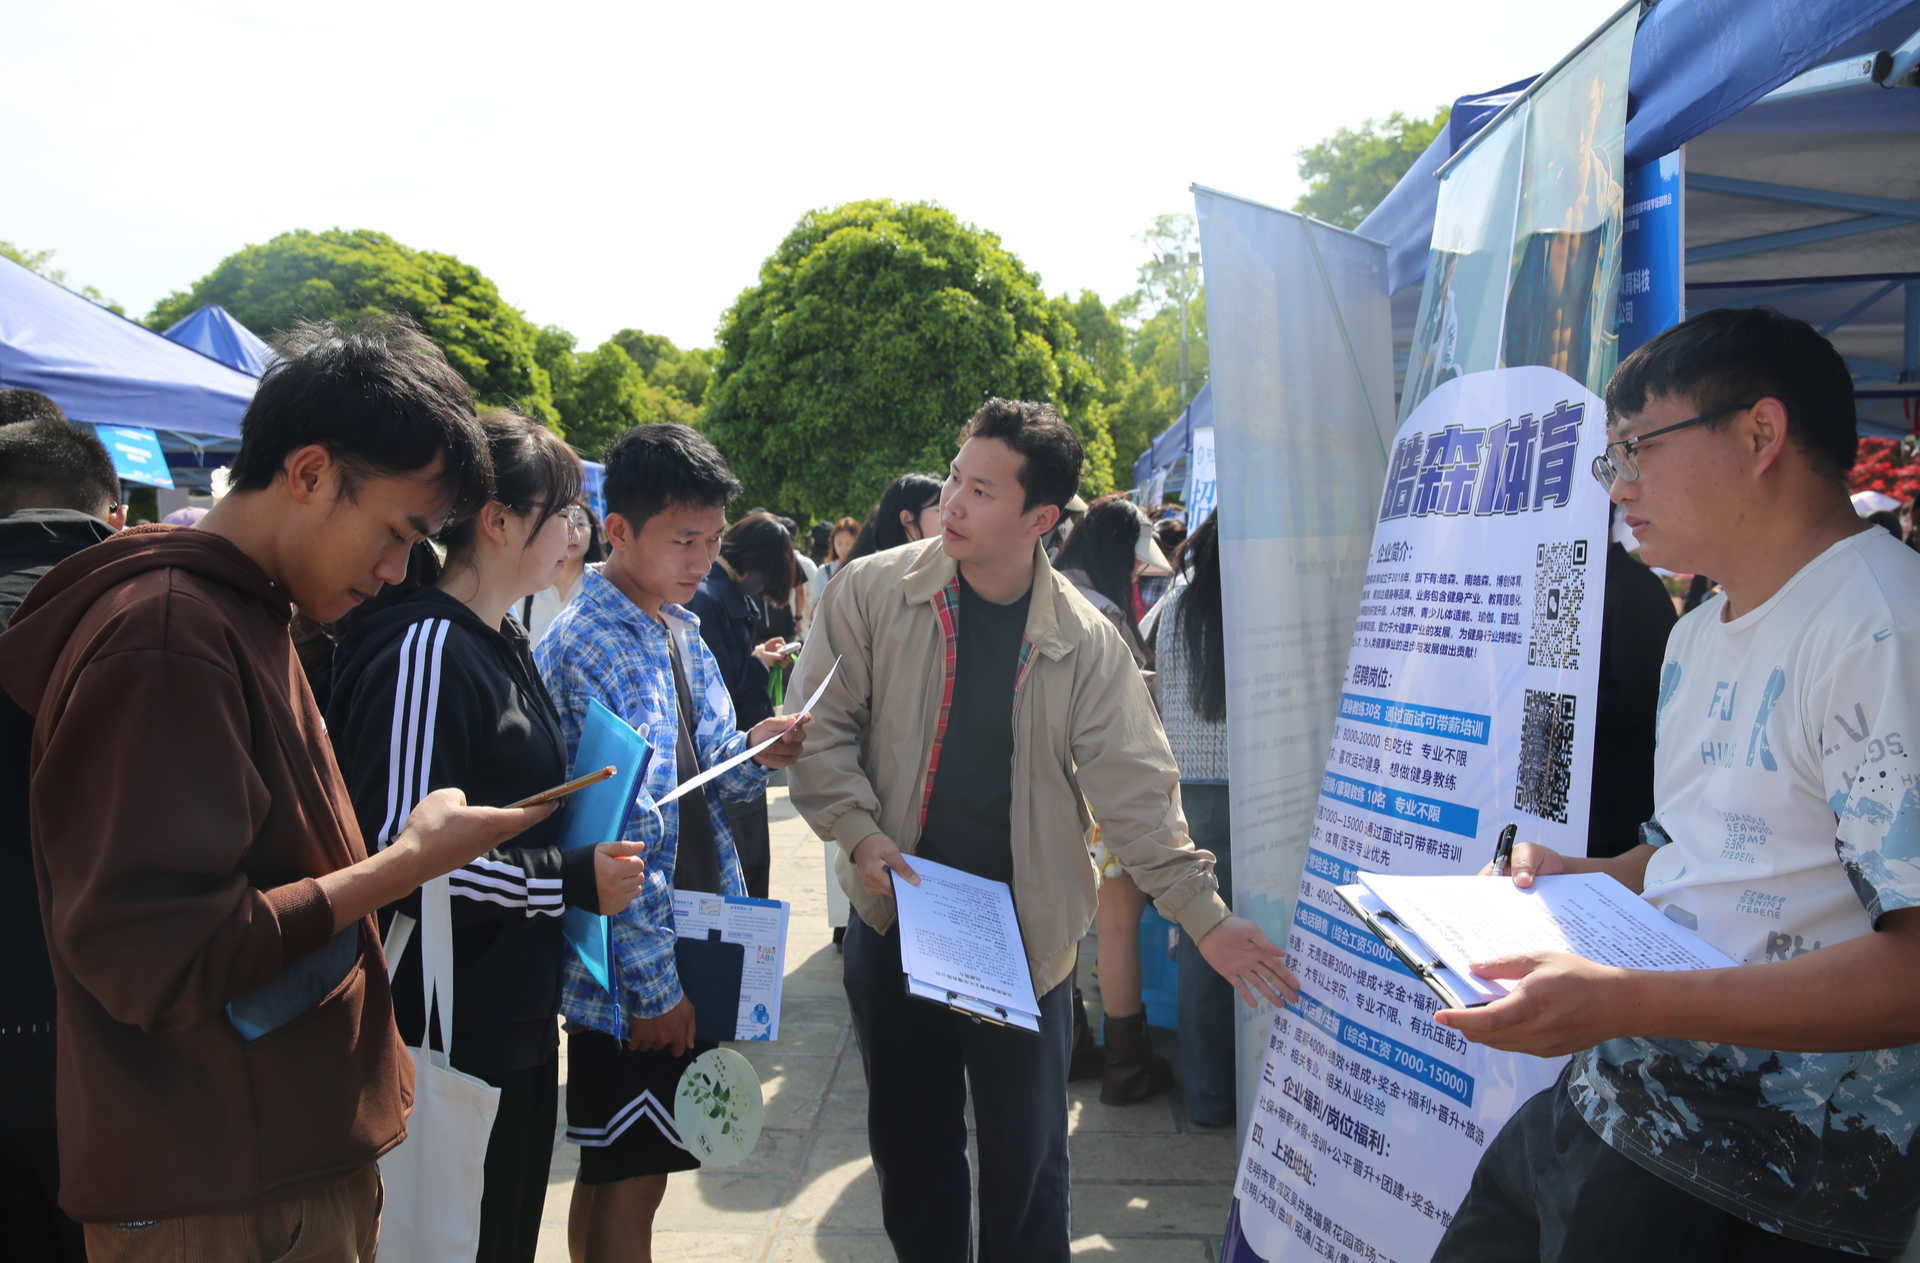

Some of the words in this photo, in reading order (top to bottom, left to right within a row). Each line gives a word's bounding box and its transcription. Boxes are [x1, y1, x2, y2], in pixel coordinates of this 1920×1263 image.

[1379, 399, 1585, 523] 皓森体育
[1384, 705, 1484, 738] 通过面试可带薪培训
[1384, 736, 1413, 756] 包吃住
[1421, 743, 1468, 767] 专业不限
[1367, 790, 1386, 809] 10名
[1395, 796, 1441, 823] 专业不限
[1364, 822, 1462, 863] 通过面试可带薪培训
